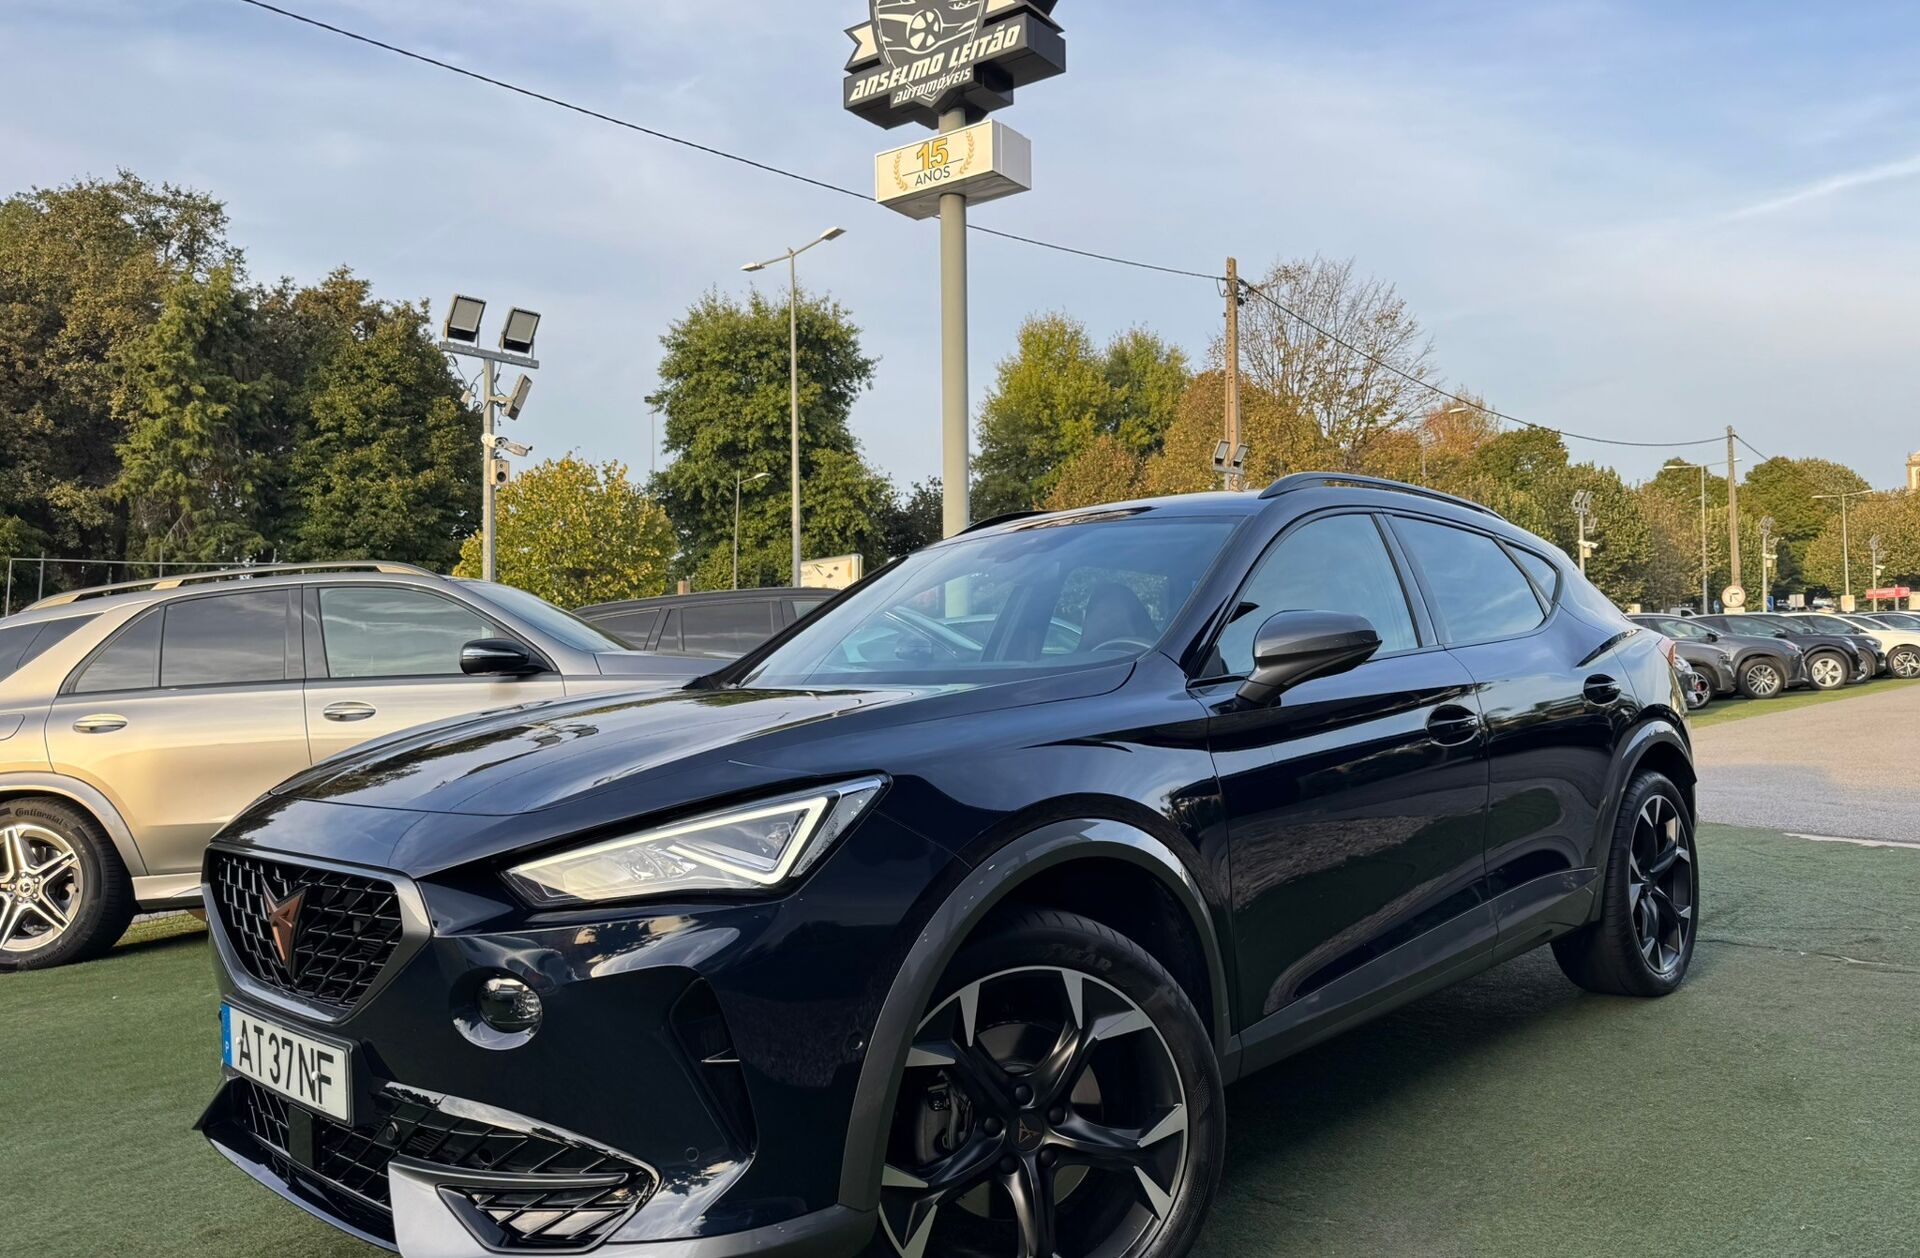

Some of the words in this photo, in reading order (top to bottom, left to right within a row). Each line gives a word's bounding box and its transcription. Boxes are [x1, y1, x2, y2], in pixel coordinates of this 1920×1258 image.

[916, 137, 949, 171] 15
[915, 166, 951, 186] ANOS
[15, 807, 64, 825] Continental
